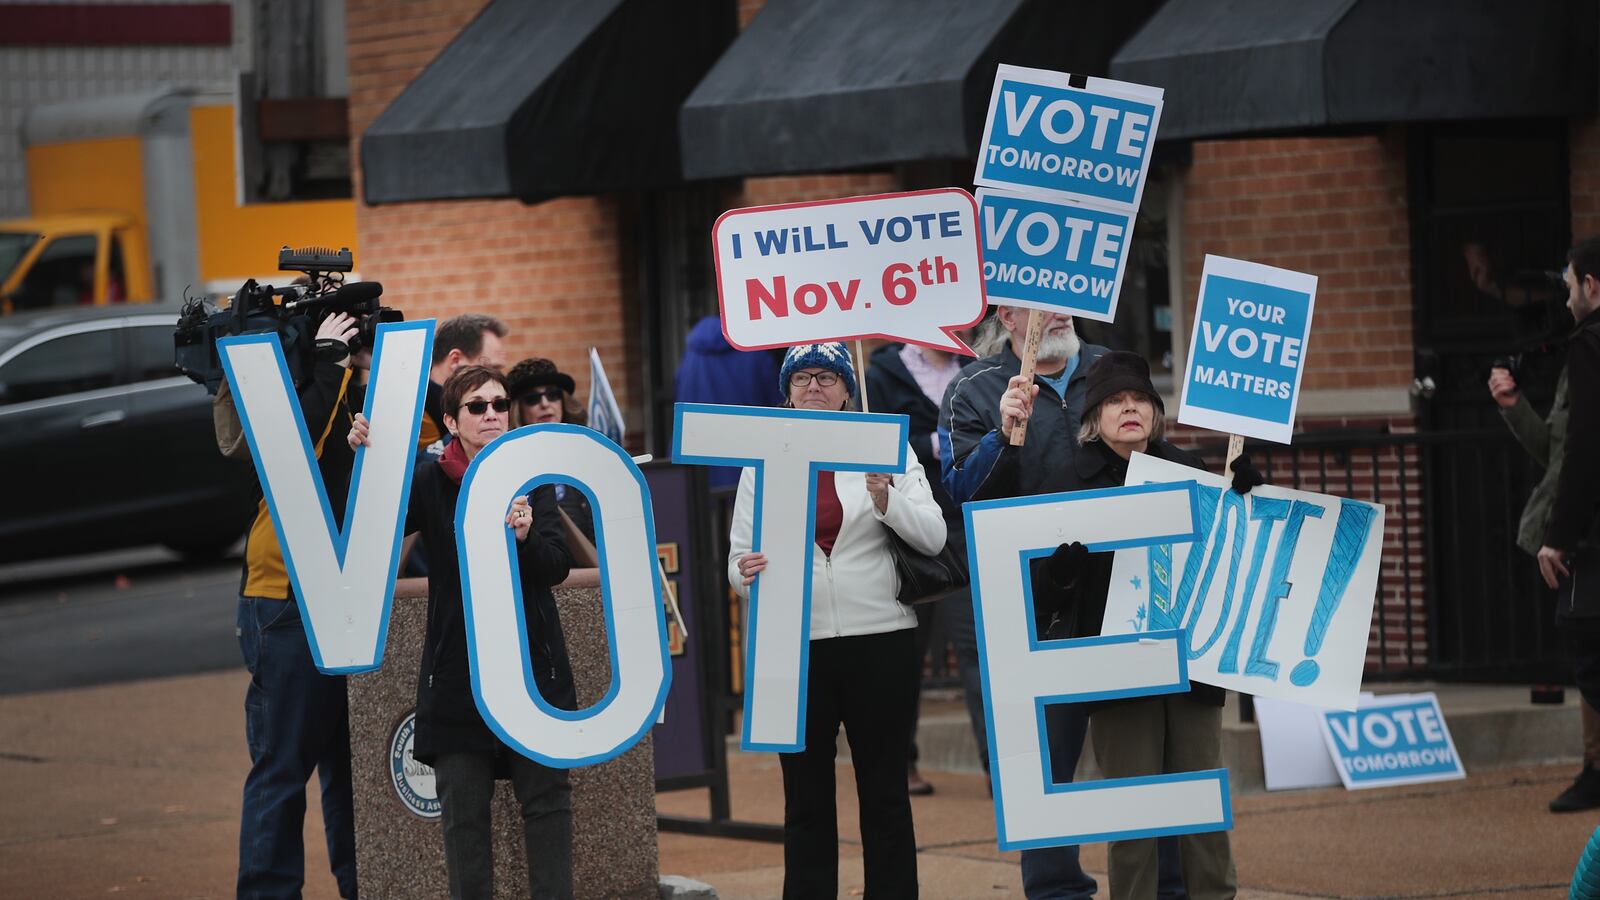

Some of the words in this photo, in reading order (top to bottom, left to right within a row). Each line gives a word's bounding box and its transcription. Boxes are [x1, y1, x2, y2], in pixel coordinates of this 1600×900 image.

[1003, 90, 1150, 158] VOTE
[988, 143, 1140, 188] TOMORROW
[731, 233, 743, 259] I
[859, 210, 963, 245] VOTE
[981, 205, 1121, 269] VOTE
[745, 275, 872, 320] Nov.
[881, 255, 960, 306] 6th
[983, 260, 1114, 299] OMORROW
[1226, 297, 1286, 325] YOUR
[1201, 320, 1301, 369] VOTE
[1193, 364, 1291, 400] MATTERS
[394, 727, 411, 759] South
[1329, 706, 1443, 751] VOTE
[1343, 747, 1453, 773] TOMORROW
[396, 772, 426, 810] Business
